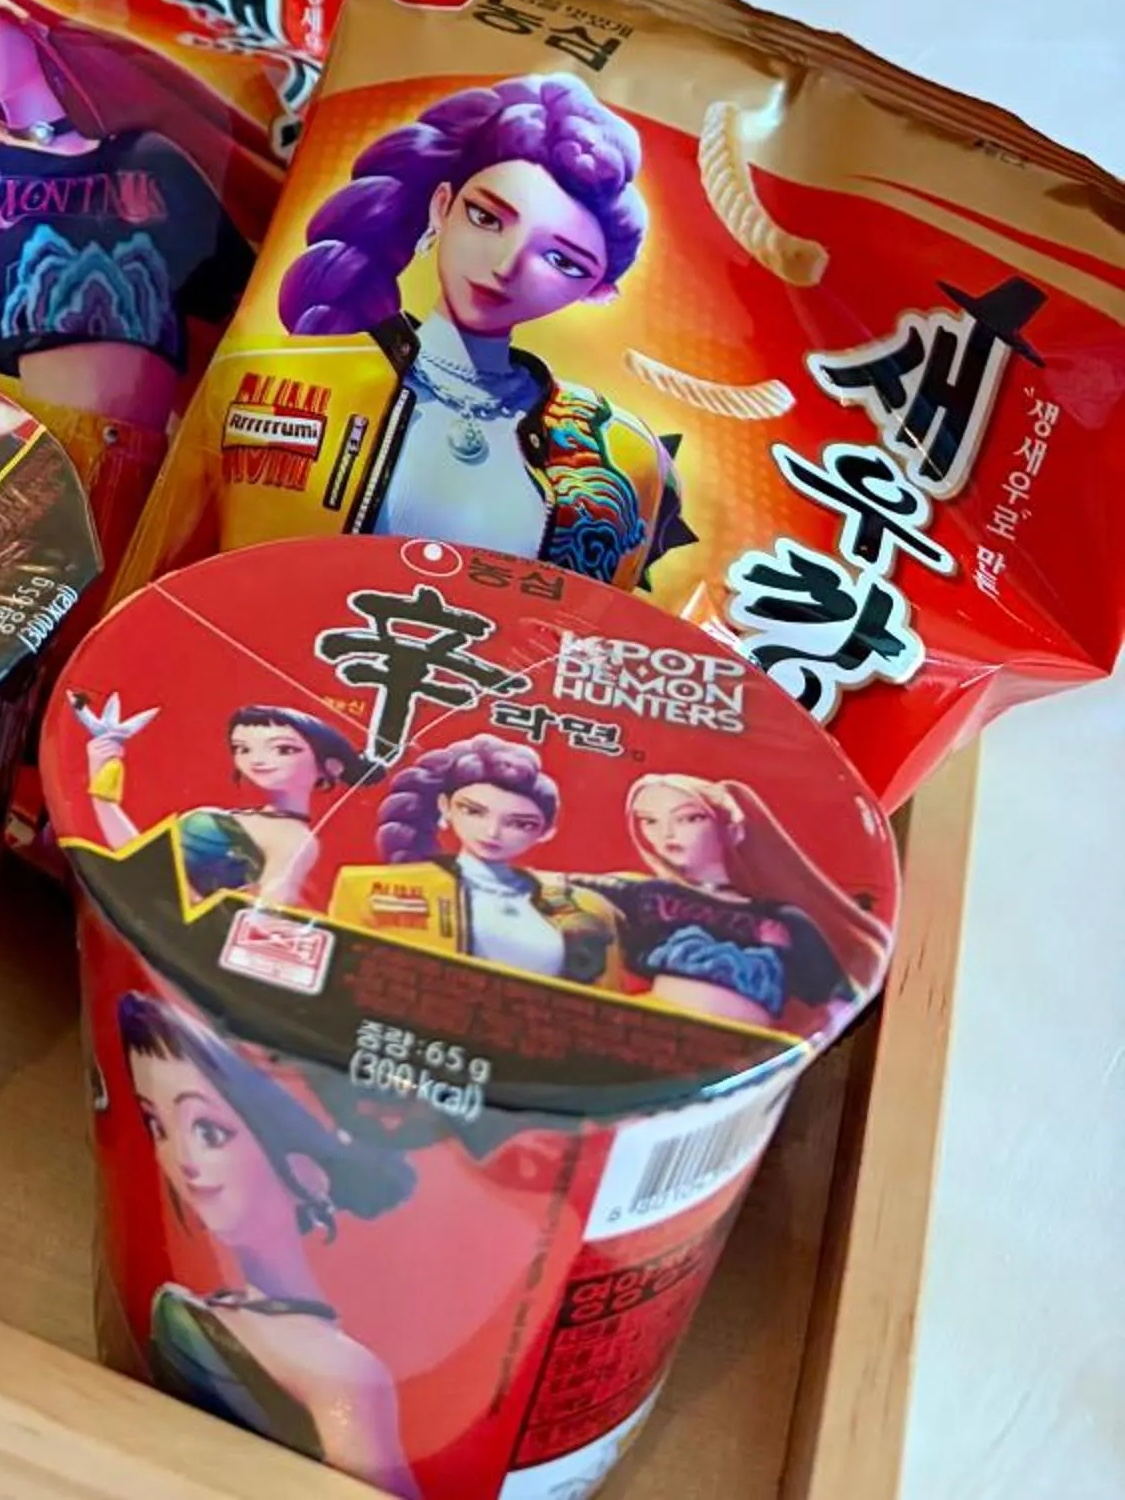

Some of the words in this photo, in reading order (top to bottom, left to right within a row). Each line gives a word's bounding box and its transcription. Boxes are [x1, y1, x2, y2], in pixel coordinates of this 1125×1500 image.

[735, 308, 1011, 722] 새우깡
[467, 553, 565, 602] 농심
[315, 584, 533, 769] 辛
[558, 654, 744, 714] DEMON
[560, 630, 746, 683] KPOP
[489, 699, 625, 757] 라면
[553, 674, 745, 734] HUNTERS
